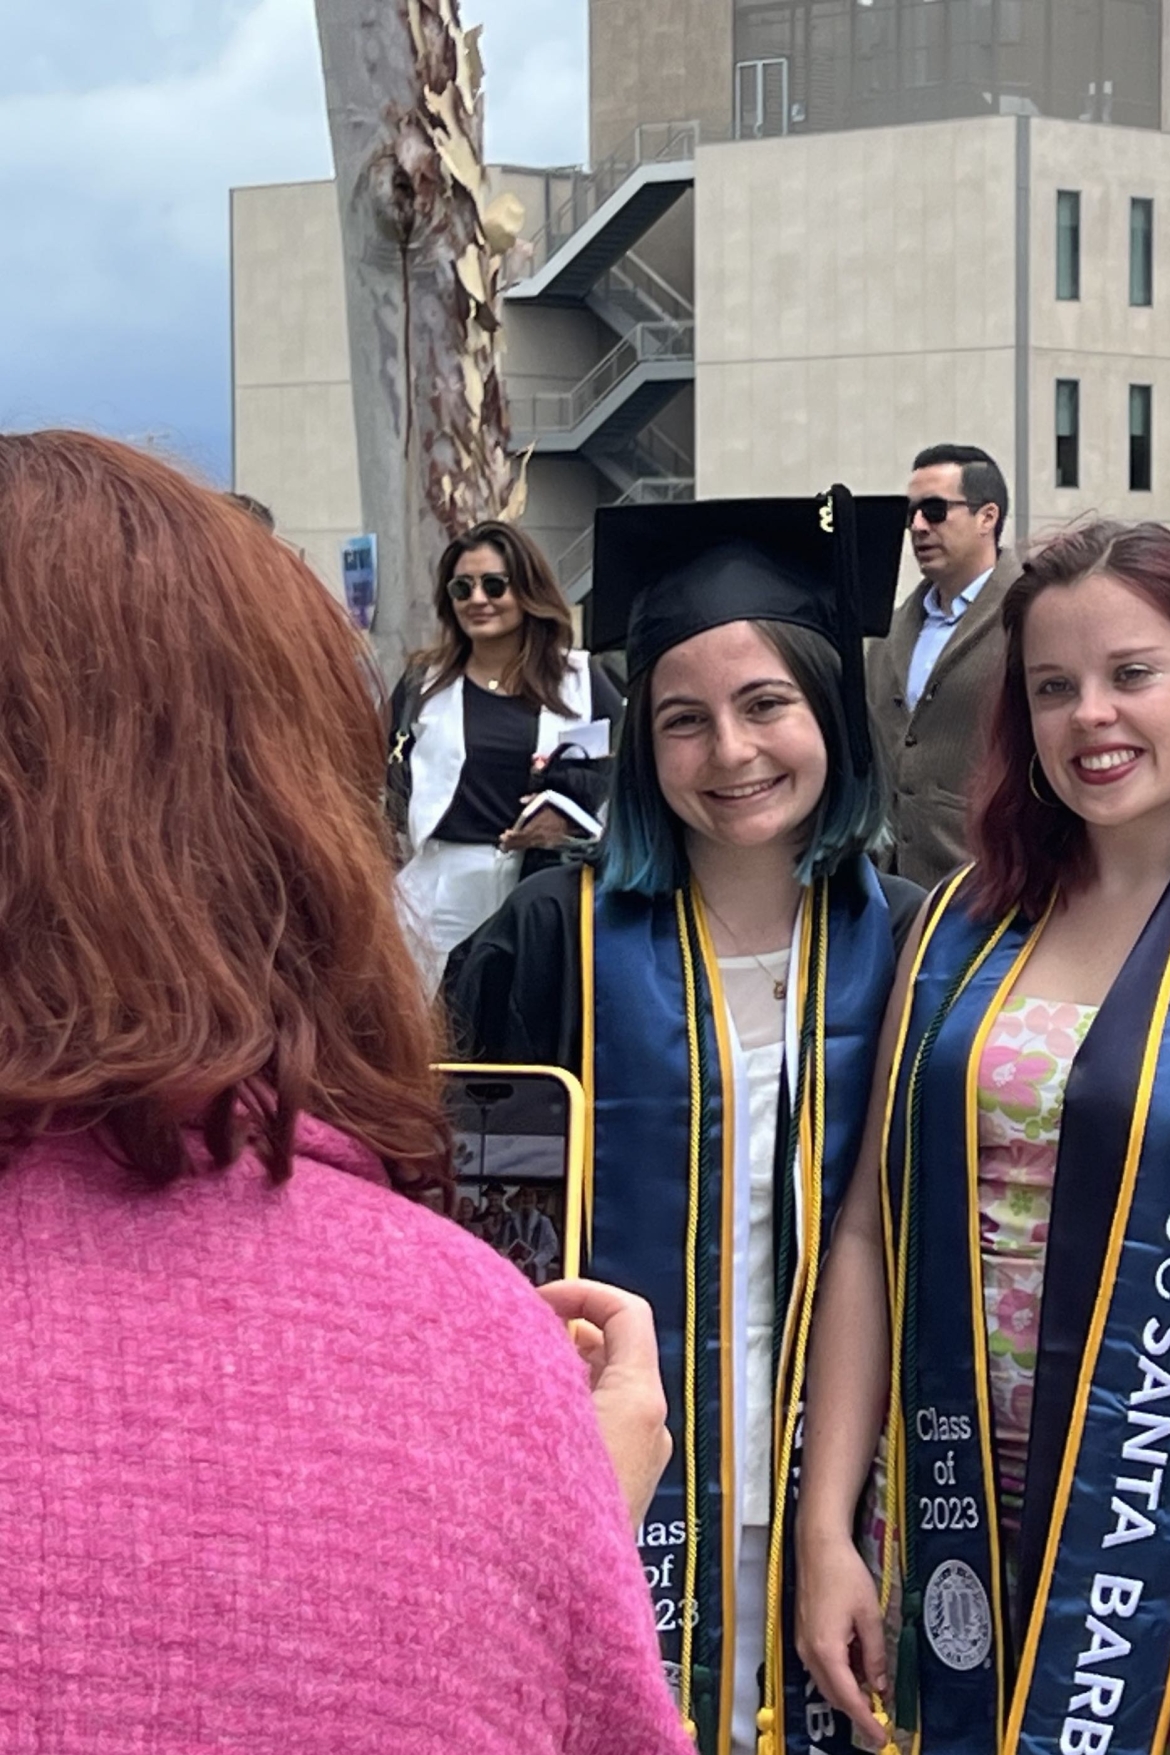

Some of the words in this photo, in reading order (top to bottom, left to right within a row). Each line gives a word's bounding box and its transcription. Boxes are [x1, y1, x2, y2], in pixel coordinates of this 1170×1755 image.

[916, 1407, 972, 1442] Class
[933, 1450, 956, 1485] of
[919, 1496, 980, 1530] 2023
[637, 1519, 701, 1548] las
[655, 1598, 699, 1631] 23
[1059, 1573, 1144, 1755] BARB
